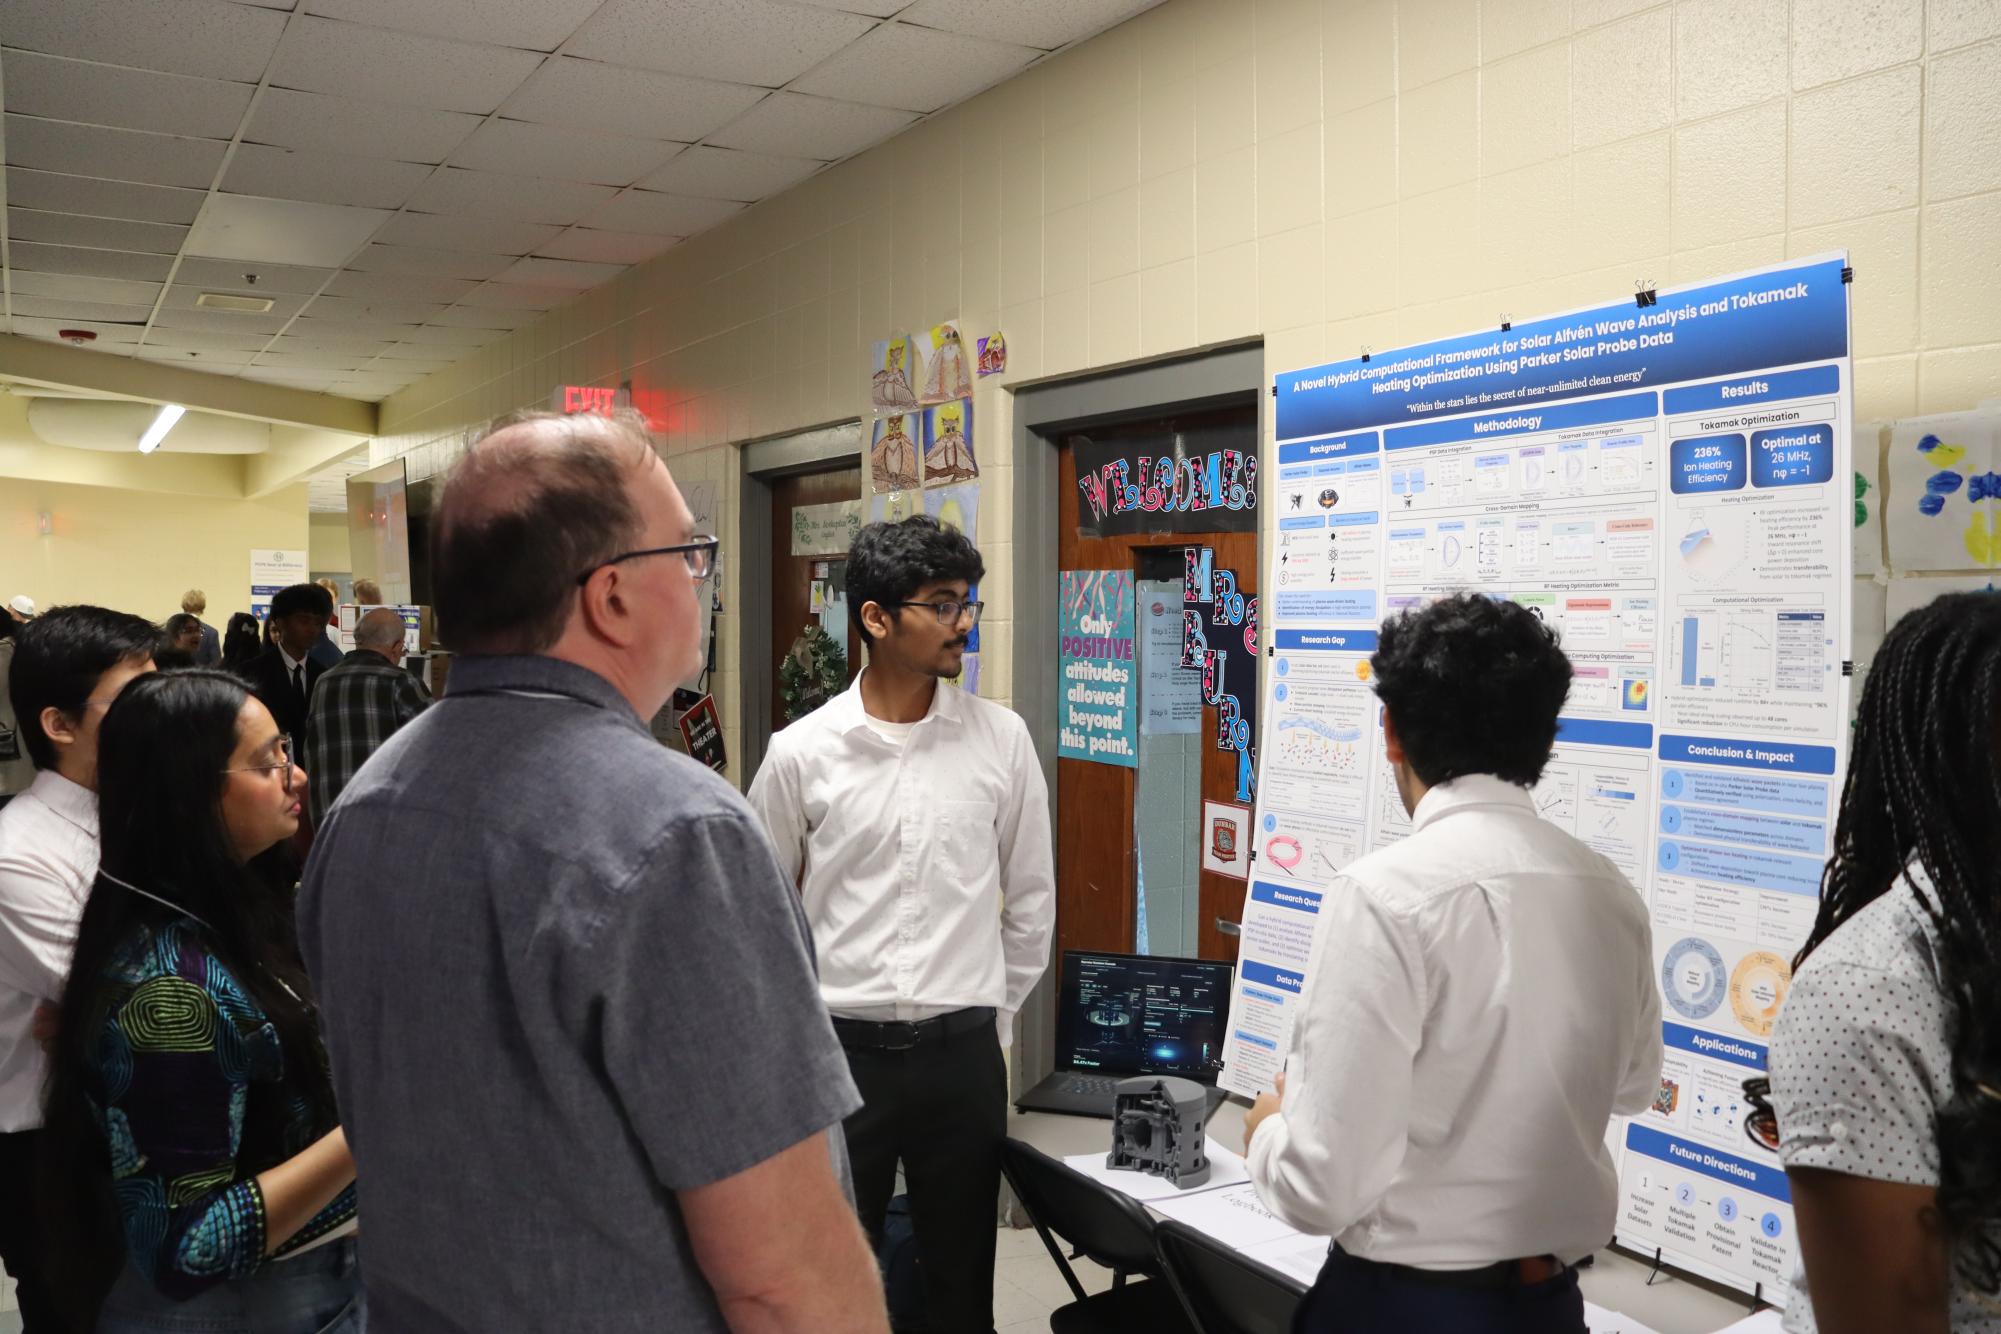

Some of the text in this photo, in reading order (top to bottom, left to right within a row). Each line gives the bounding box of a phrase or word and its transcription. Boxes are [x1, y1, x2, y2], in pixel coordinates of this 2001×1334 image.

[1293, 283, 1809, 392] A Novel Hybrid Computational Framework for Solar Alfvén Wave Analysis and Tokamak
[1372, 331, 1674, 395] Heating Optimization Using Parker Solar Probe Data
[1434, 400, 1446, 410] the
[1446, 397, 1464, 408] stars
[1465, 394, 1478, 406] lies
[1479, 393, 1492, 404] the
[1492, 389, 1516, 402] secret
[1517, 386, 1526, 398] of
[1527, 377, 1587, 397] near-unlimited
[1589, 374, 1611, 388] clean
[1721, 380, 1769, 399] Results
[1473, 415, 1542, 434] Methodology
[1699, 411, 1800, 431] Tokamak Optimization
[1582, 431, 1594, 439] Data
[1594, 427, 1624, 436] Integration
[1309, 441, 1347, 455] Background
[1761, 433, 1822, 452] Optimal at
[1694, 446, 1721, 458] 236%
[1771, 450, 1812, 464] 26 MHz,
[1683, 459, 1732, 472] Ion Heating
[1079, 449, 1258, 522] WELCOME!
[1687, 472, 1728, 484] Efficiency
[1721, 494, 1775, 505] Heating Optimization
[1712, 596, 1784, 604] Computational Optimization
[1080, 614, 1113, 639] Only
[1062, 635, 1133, 661] POSITIVE
[1301, 635, 1346, 647] Research Gap
[1065, 660, 1129, 684] attitudes
[1067, 683, 1126, 708] allowed
[1069, 705, 1123, 733] beyond
[692, 726, 718, 751] THEATER
[1061, 727, 1134, 757] this point.
[1687, 744, 1794, 764] Conclusion & Impact
[1274, 890, 1303, 906] Research
[1276, 974, 1293, 987] Data
[1692, 1034, 1758, 1060] Applications
[1669, 1143, 1757, 1181] Future Directions
[1642, 1176, 1648, 1188] 1
[1630, 1192, 1655, 1207] Increase
[1682, 1189, 1689, 1201] 2
[1633, 1204, 1649, 1216] Solar
[1669, 1205, 1697, 1221] Multiple
[1724, 1205, 1731, 1216] 3
[1627, 1212, 1653, 1228] Datasets
[1667, 1215, 1696, 1232] Tokamak
[1767, 1220, 1775, 1233] 4
[1664, 1225, 1696, 1243] Validation
[1713, 1222, 1736, 1236] Obtain
[1706, 1231, 1742, 1250] Provisional
[1750, 1235, 1778, 1251] Validate
[1711, 1244, 1733, 1258] Patent
[1751, 1247, 1782, 1265] Tokamak
[1752, 1259, 1779, 1275] Reactor
